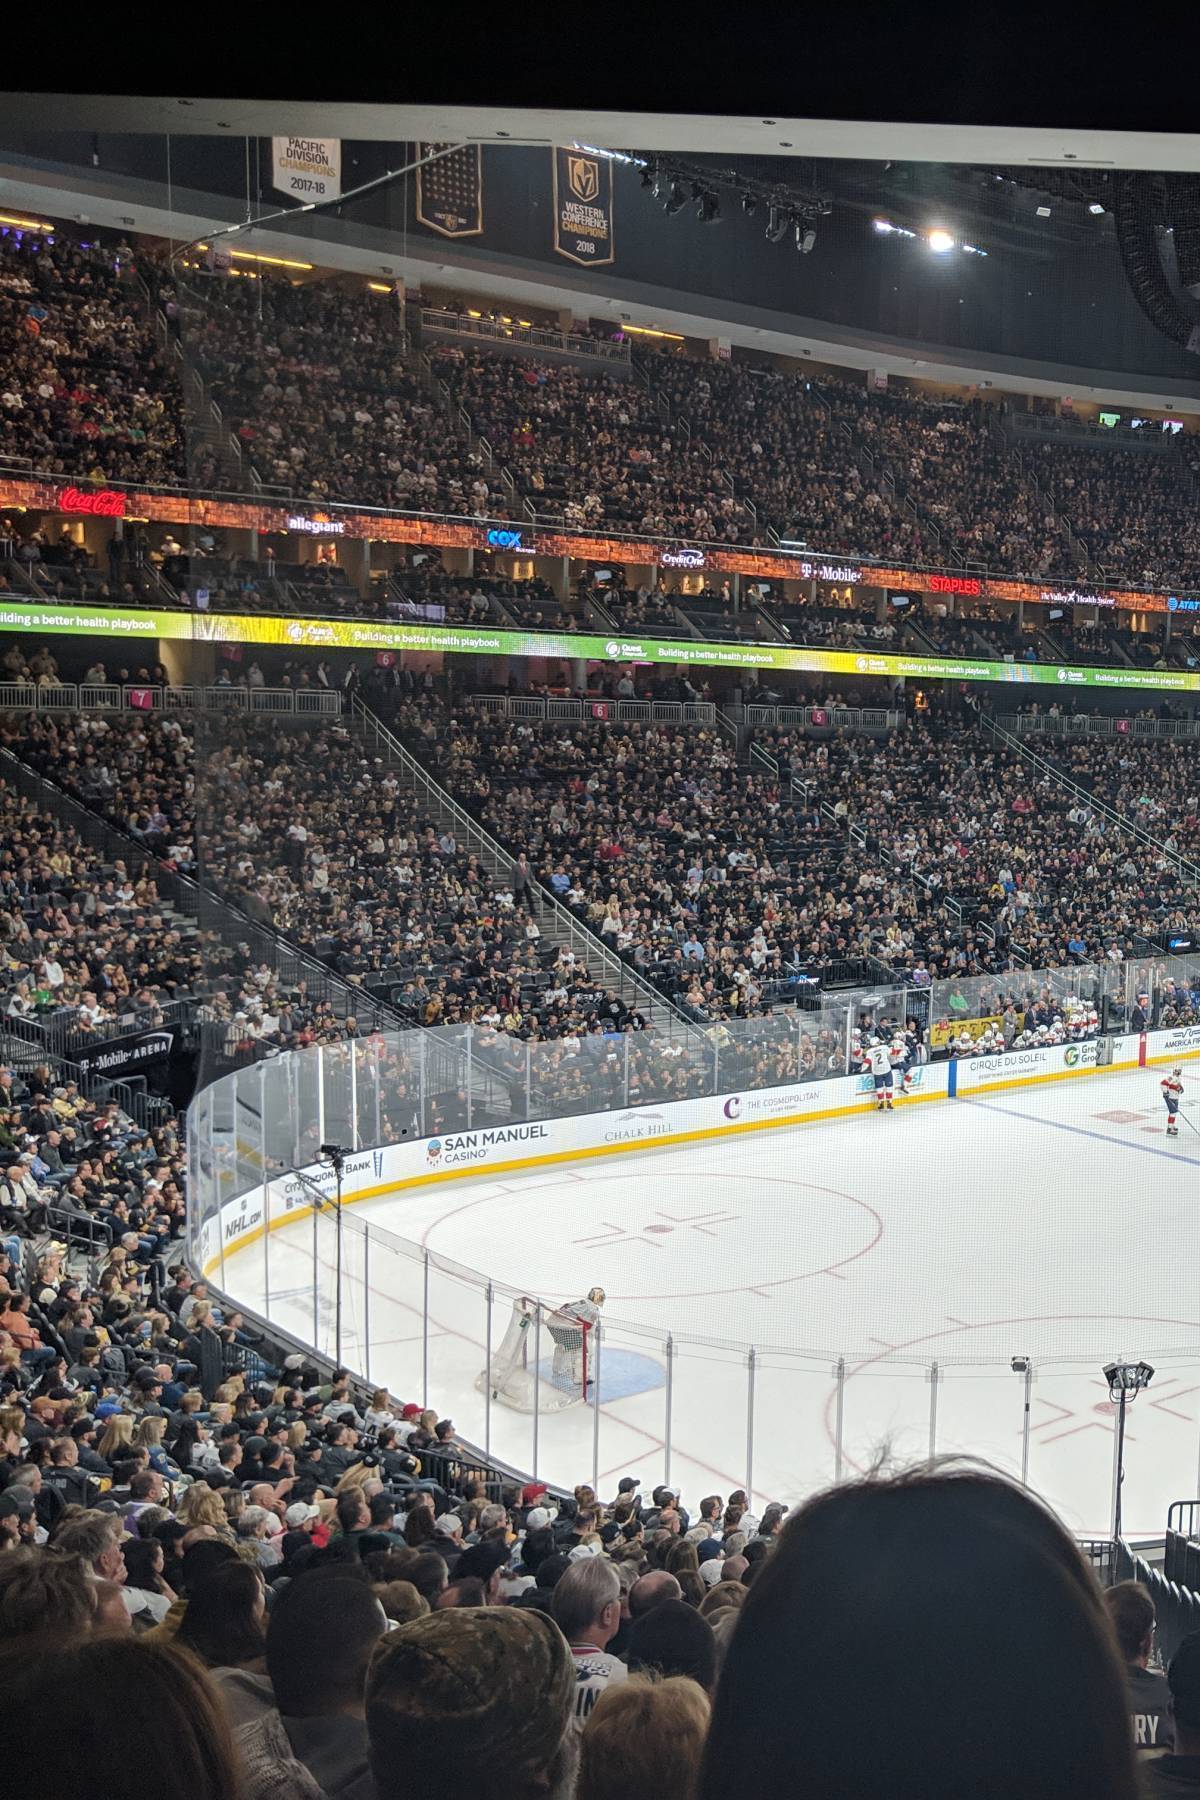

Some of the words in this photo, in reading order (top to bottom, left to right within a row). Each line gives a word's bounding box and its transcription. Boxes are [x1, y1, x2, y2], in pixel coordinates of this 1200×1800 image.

[288, 138, 326, 154] PACIFIC
[286, 147, 329, 166] DIVISION
[279, 157, 337, 177] CHAMPIONS
[290, 177, 326, 195] 2017-18
[565, 201, 604, 220] WESTERN
[562, 211, 608, 230] CONFERENCE
[562, 221, 608, 240] CHAMPIONS
[576, 240, 595, 254] 2018
[289, 515, 344, 533] allegiant
[931, 576, 980, 595] STAPLES
[1178, 600, 1200, 611] AT&T
[42, 614, 74, 626] better
[76, 616, 109, 628] health
[111, 619, 156, 631] playbook
[354, 630, 393, 644] Building
[402, 633, 429, 644] better
[431, 635, 460, 646] health
[462, 638, 500, 648] playbook
[382, 654, 389, 666] 6
[658, 647, 689, 659] Building
[696, 651, 718, 660] better
[719, 652, 741, 661] health
[742, 653, 773, 664] playbook
[137, 692, 145, 705] 7
[596, 706, 604, 717] 6
[133, 1041, 167, 1059] ARENA
[1164, 1038, 1192, 1049] AMERICA
[876, 1053, 883, 1064] 2
[970, 1059, 1002, 1071] CIRQUE
[1004, 1057, 1015, 1066] DU
[1018, 1053, 1047, 1064] SOLEIL
[749, 1099, 761, 1109] THE
[763, 1092, 820, 1107] COSMOPOLITAN
[444, 1136, 477, 1151] SAN
[482, 1125, 548, 1147] MANUEL
[604, 1128, 644, 1142] CHALK
[648, 1123, 674, 1134] HILL
[444, 1149, 487, 1163] CASINO
[345, 1159, 372, 1174] BANK
